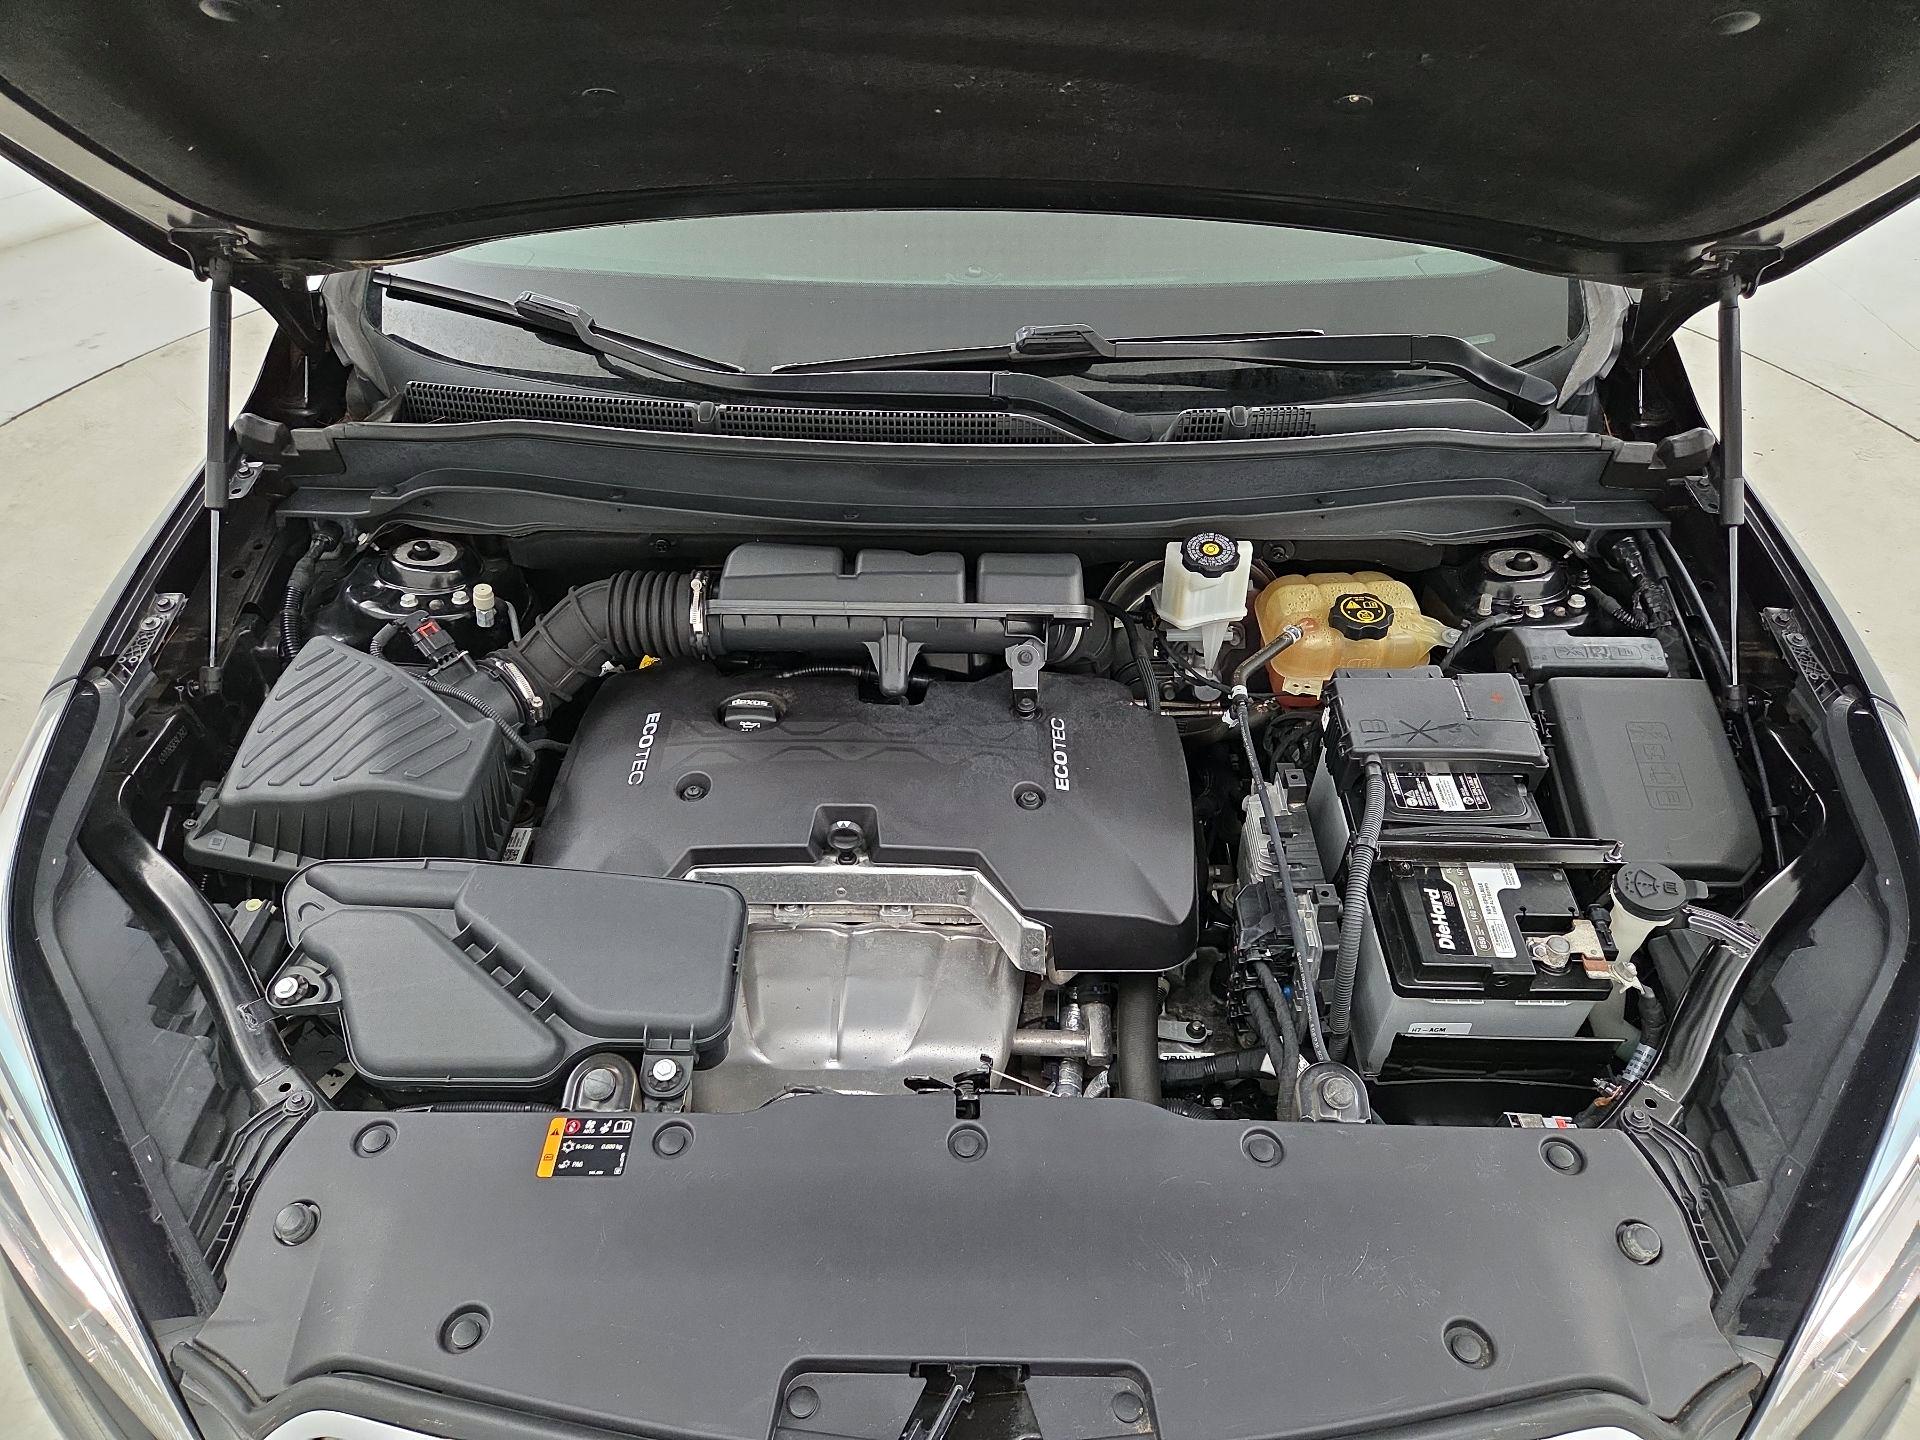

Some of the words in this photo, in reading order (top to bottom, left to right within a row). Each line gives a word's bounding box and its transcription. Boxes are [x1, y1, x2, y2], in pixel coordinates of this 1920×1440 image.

[731, 698, 770, 707] dexos
[627, 712, 662, 786] ECOTEC
[1050, 717, 1070, 791] ECOTEC
[1423, 888, 1456, 950] DieHard
